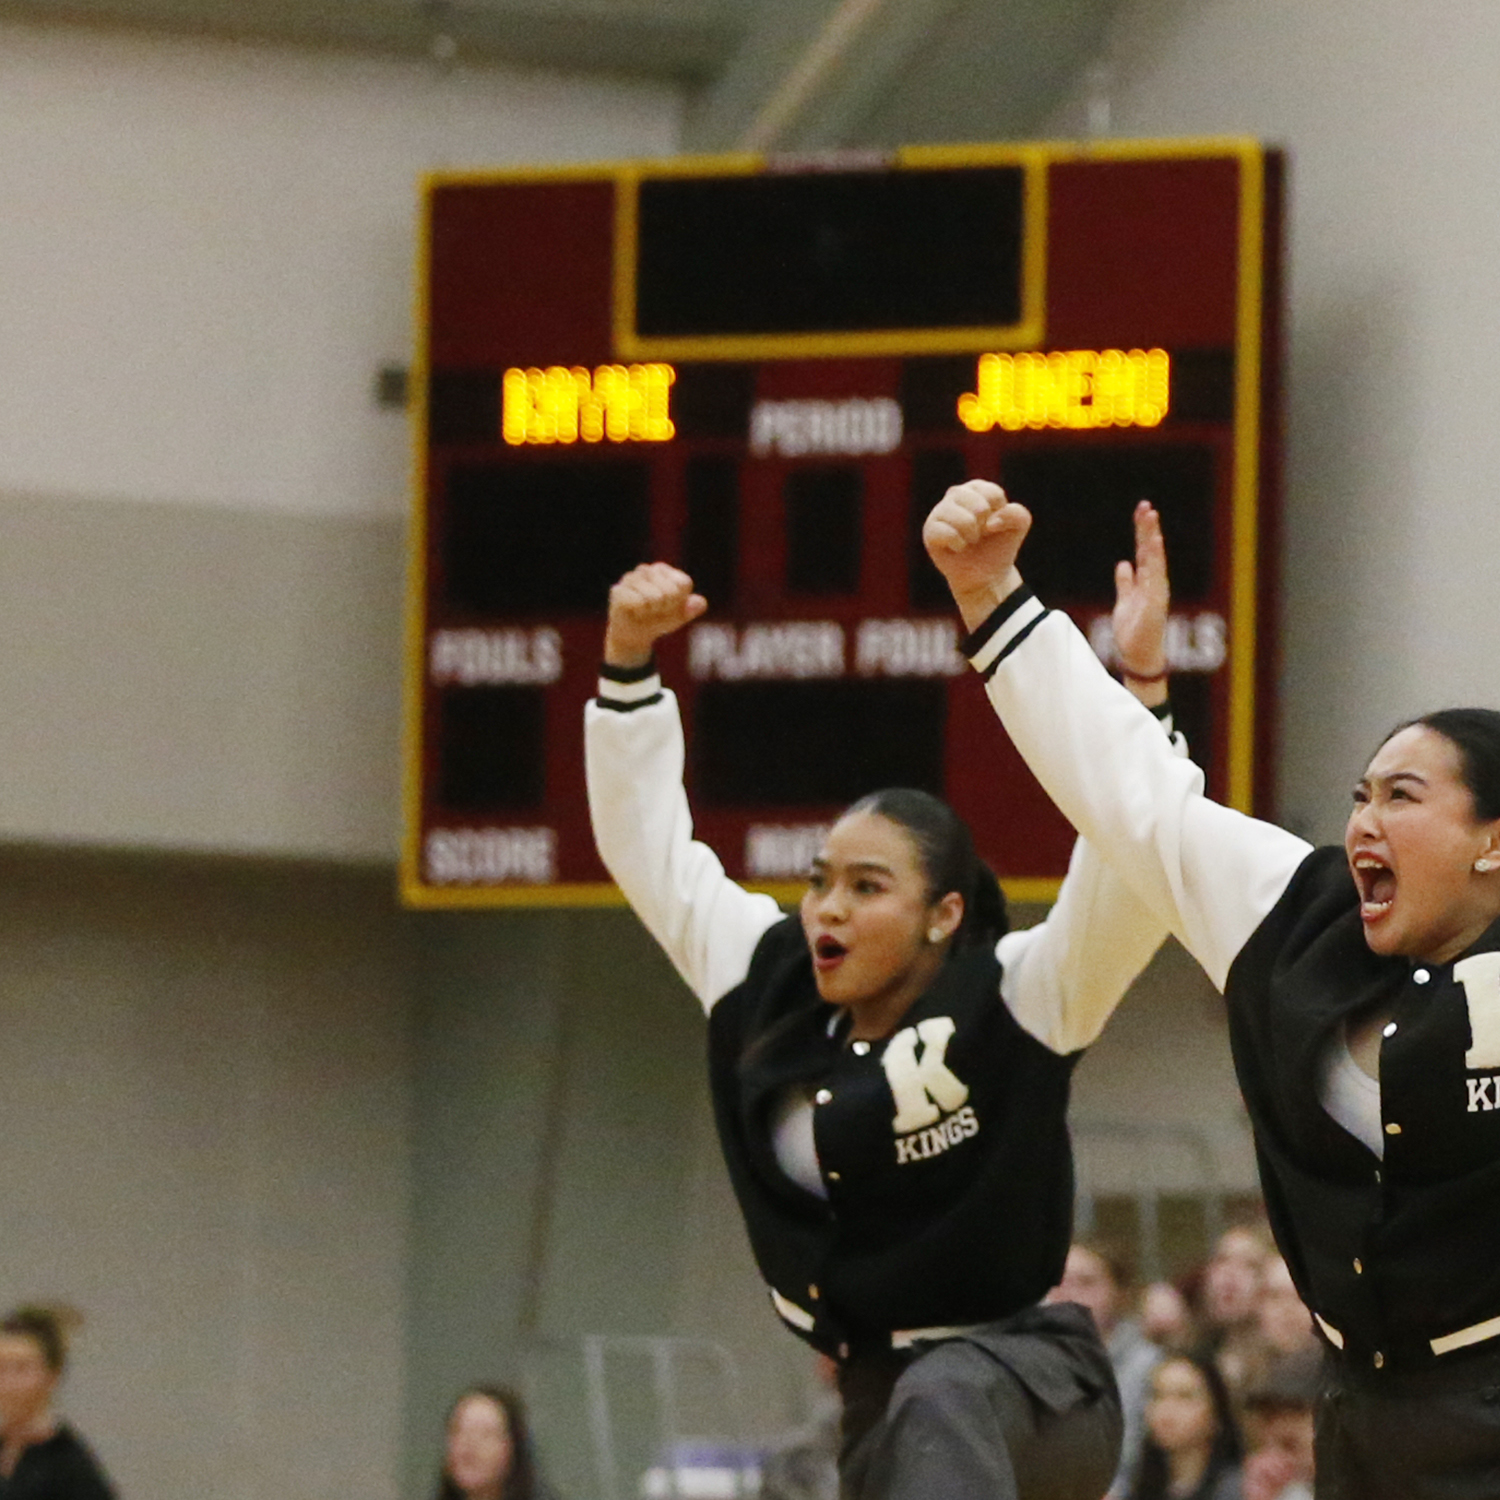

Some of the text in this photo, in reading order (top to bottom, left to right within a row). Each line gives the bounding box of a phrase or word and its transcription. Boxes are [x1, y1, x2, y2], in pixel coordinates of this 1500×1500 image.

[429, 626, 563, 686] FOULS
[880, 1016, 970, 1134] K
[894, 1106, 981, 1165] KINGS
